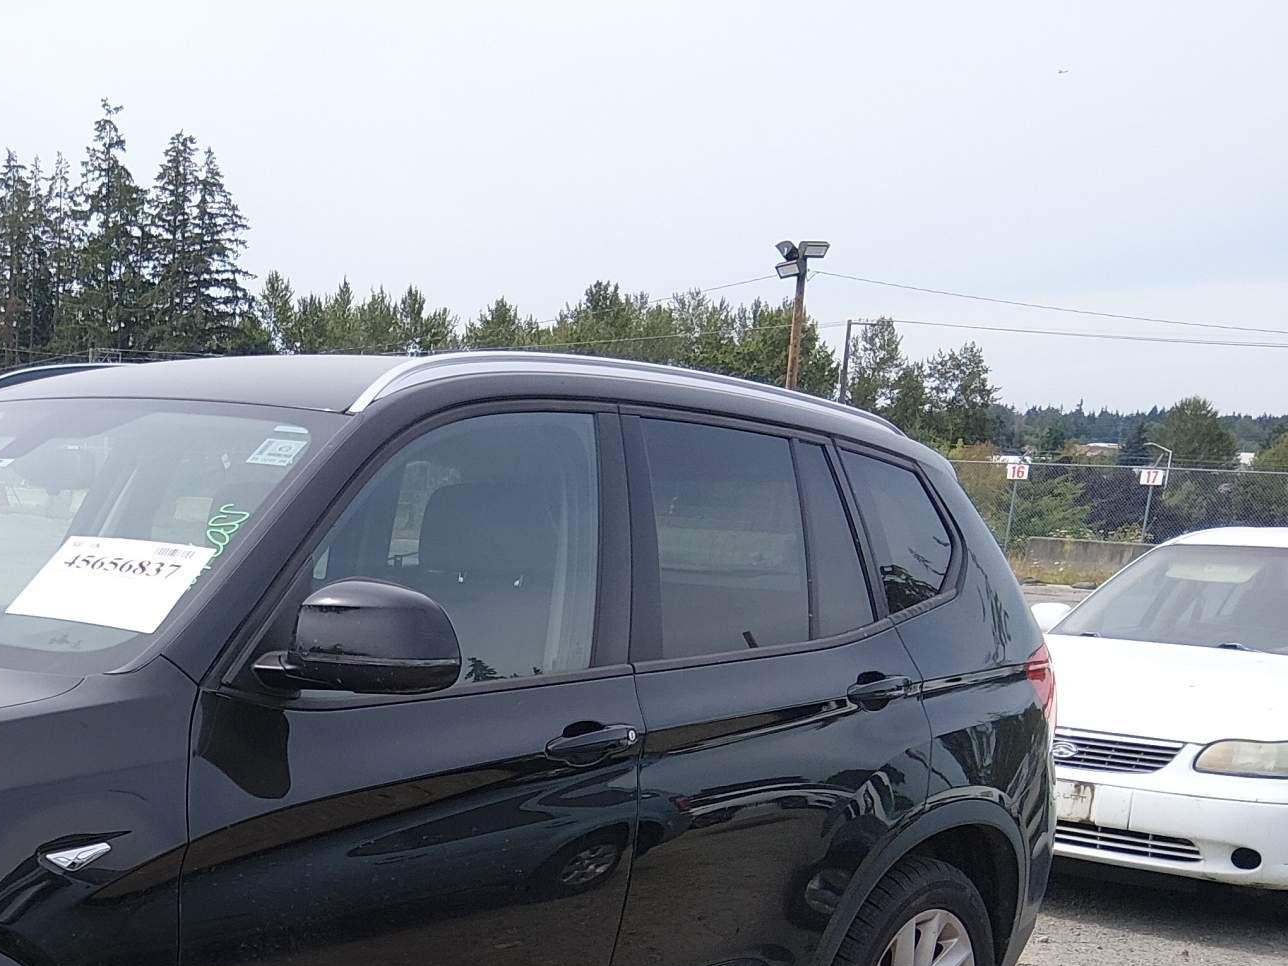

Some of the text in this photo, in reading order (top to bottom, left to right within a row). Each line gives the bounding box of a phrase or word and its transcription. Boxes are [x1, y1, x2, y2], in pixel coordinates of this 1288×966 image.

[1011, 465, 1025, 479] 16
[1145, 470, 1159, 484] 17
[64, 553, 182, 580] 45656837
